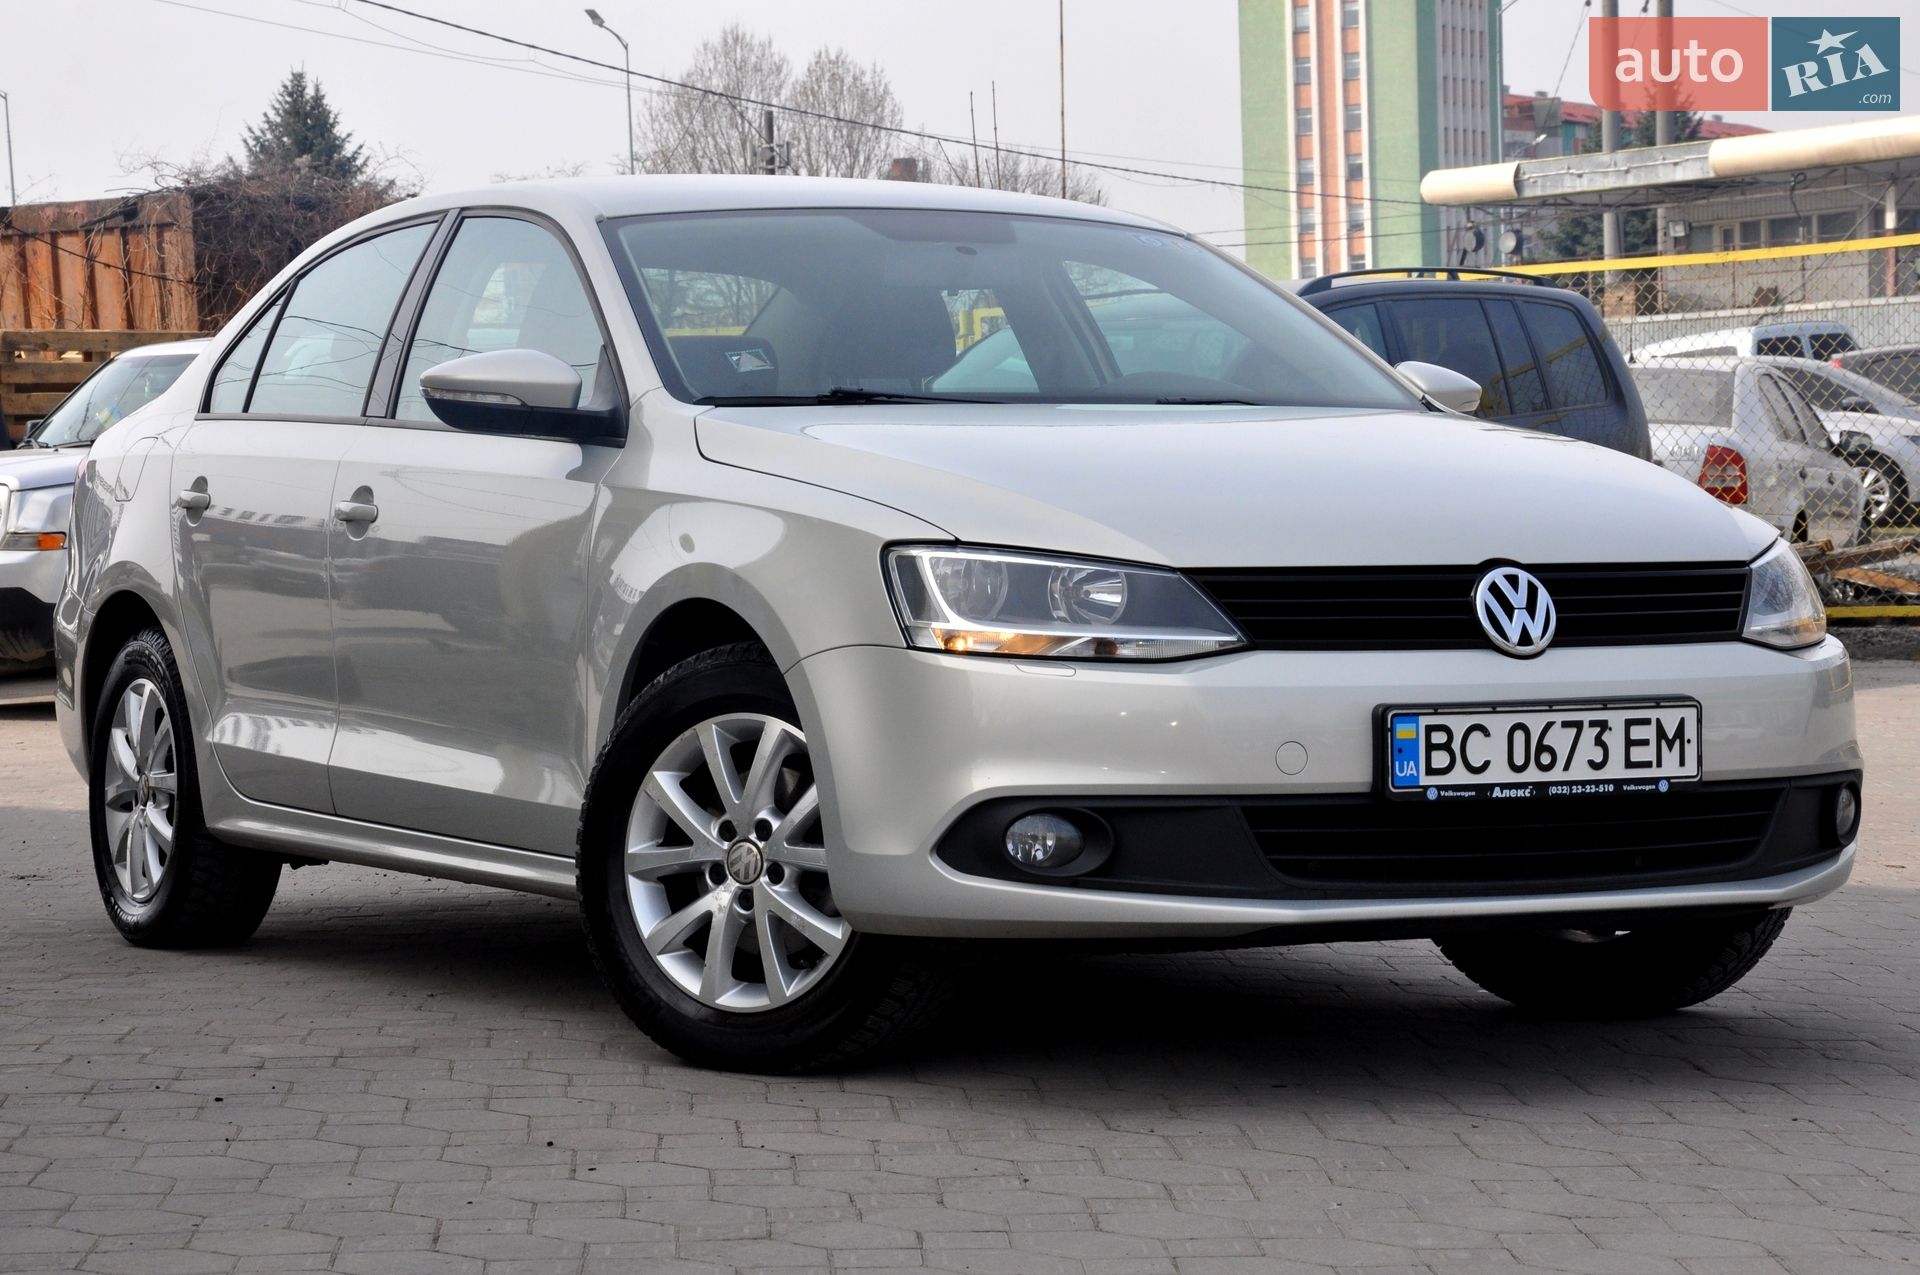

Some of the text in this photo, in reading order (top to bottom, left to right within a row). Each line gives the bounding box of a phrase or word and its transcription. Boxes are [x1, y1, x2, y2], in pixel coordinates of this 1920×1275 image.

[1424, 717, 1686, 777] BC 0673 EM
[1395, 761, 1418, 777] UA
[1548, 786, 1570, 796] (032)
[1571, 784, 1614, 794] 23-23-510
